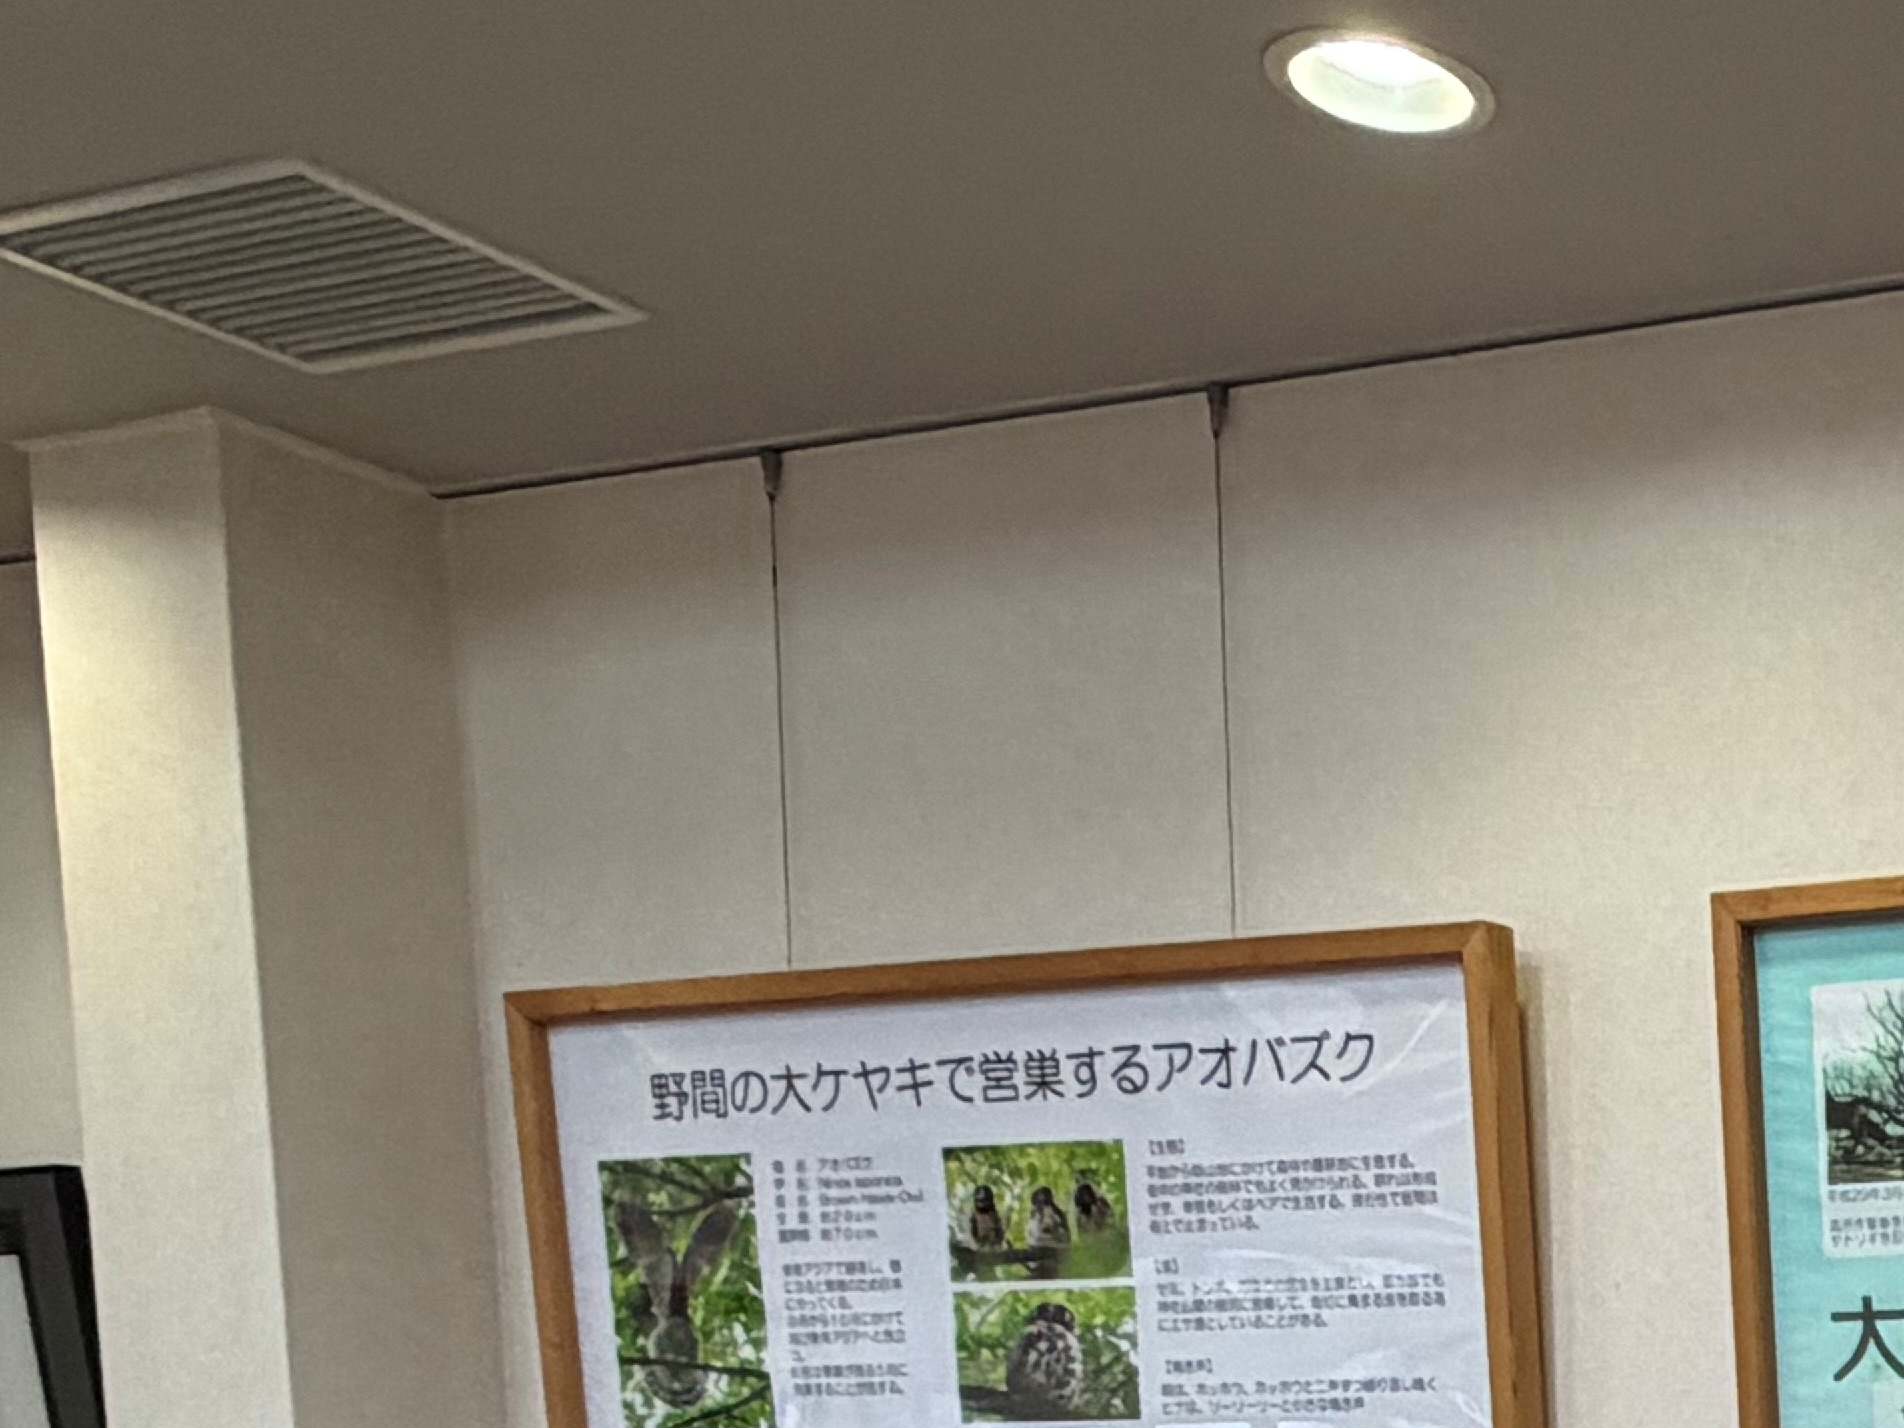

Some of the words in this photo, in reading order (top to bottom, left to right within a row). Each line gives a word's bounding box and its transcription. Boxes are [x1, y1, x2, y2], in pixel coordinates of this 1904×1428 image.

[650, 1032, 1377, 1121] 野間の大ケヤキで営巣するアオバズク
